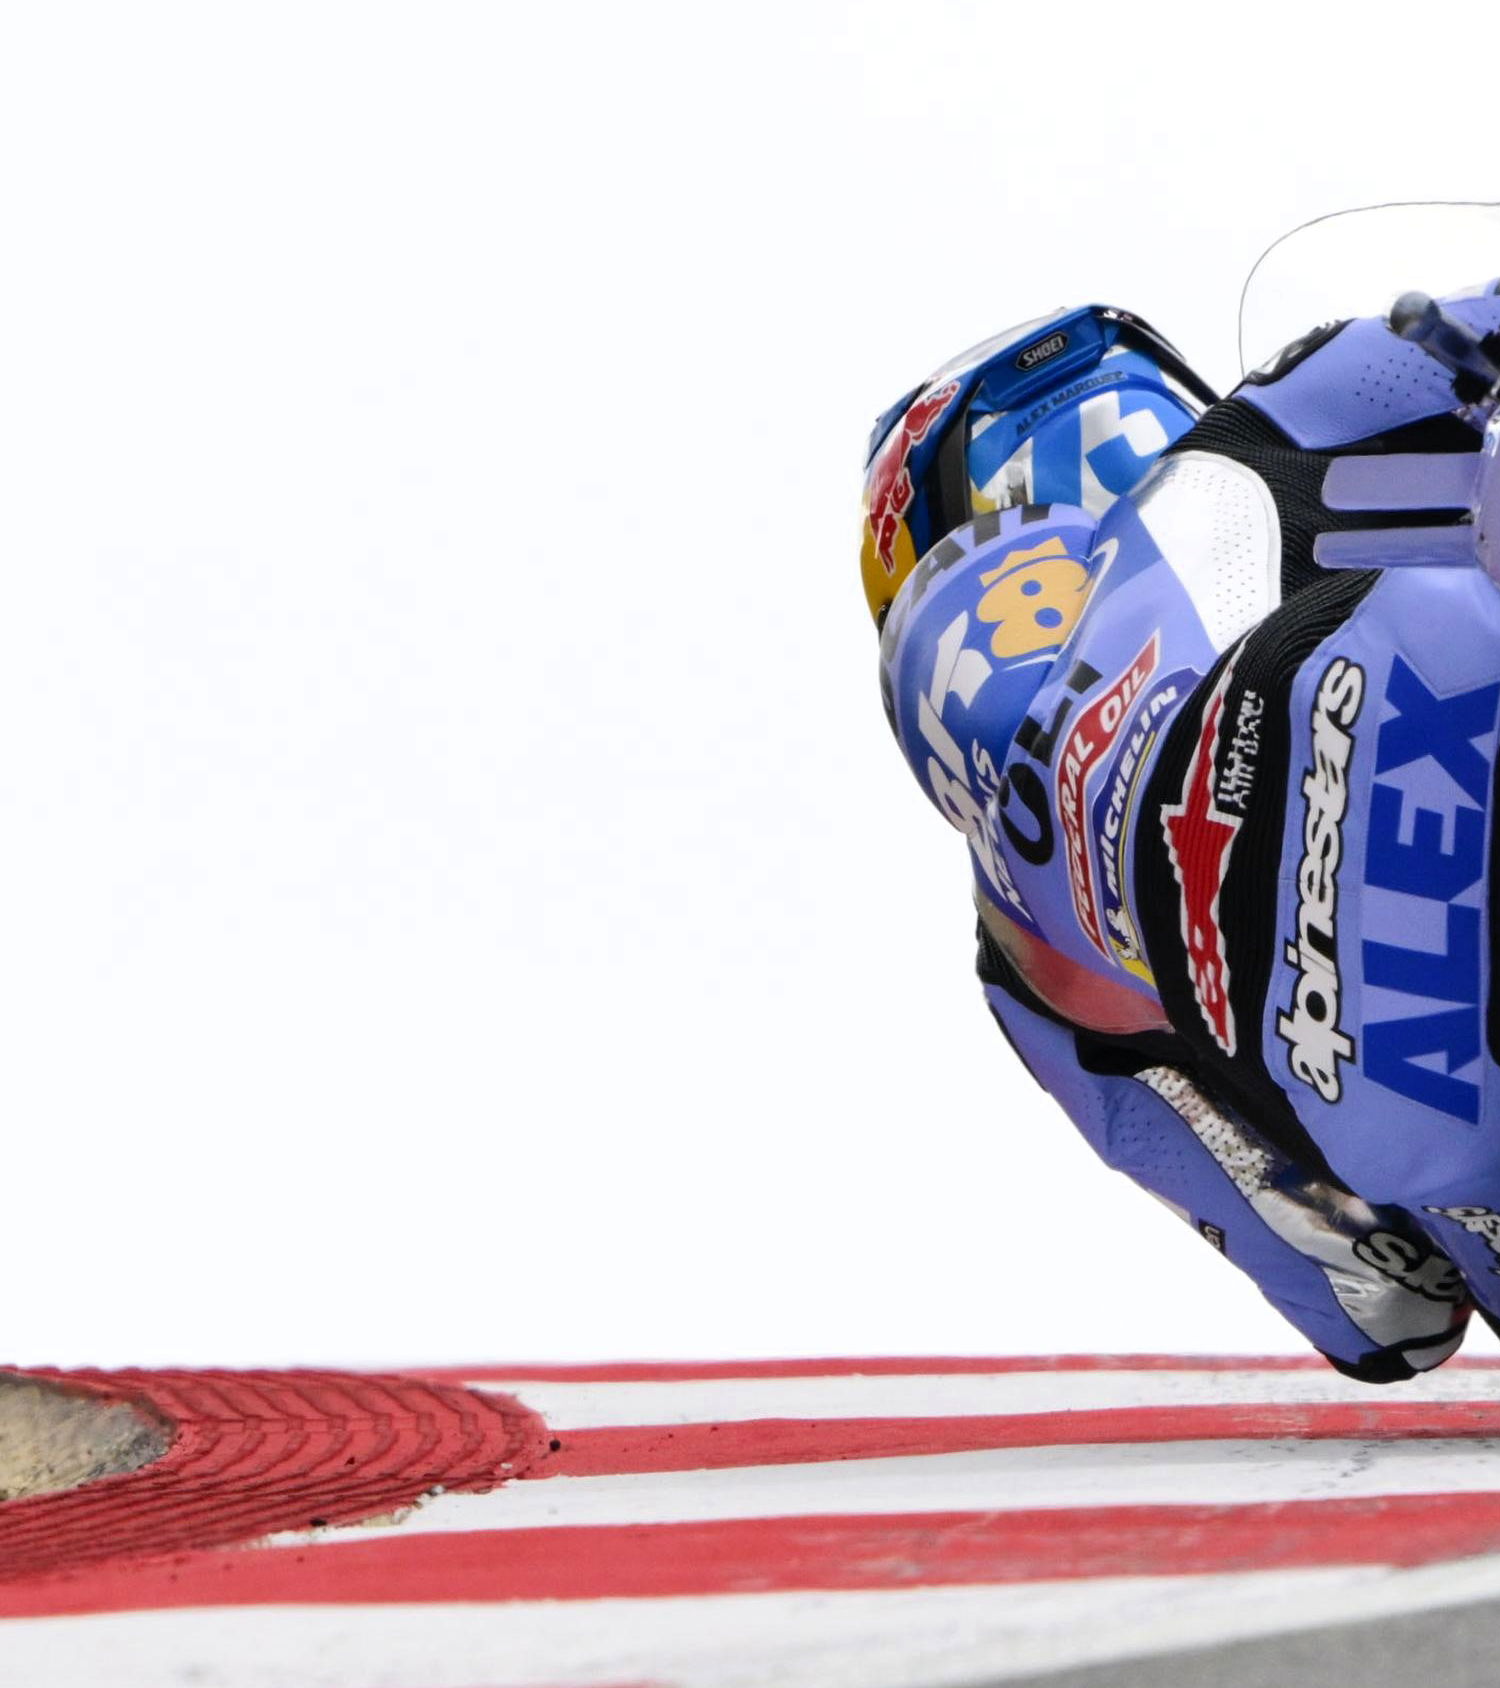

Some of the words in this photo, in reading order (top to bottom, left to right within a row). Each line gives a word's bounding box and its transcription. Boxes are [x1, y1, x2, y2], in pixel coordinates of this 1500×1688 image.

[1020, 334, 1066, 368] SHOEI
[1016, 402, 1049, 437] ALEX
[1100, 668, 1146, 733] OIL
[1101, 685, 1178, 897] MICHELIN
[1278, 657, 1364, 1103] alpinestars
